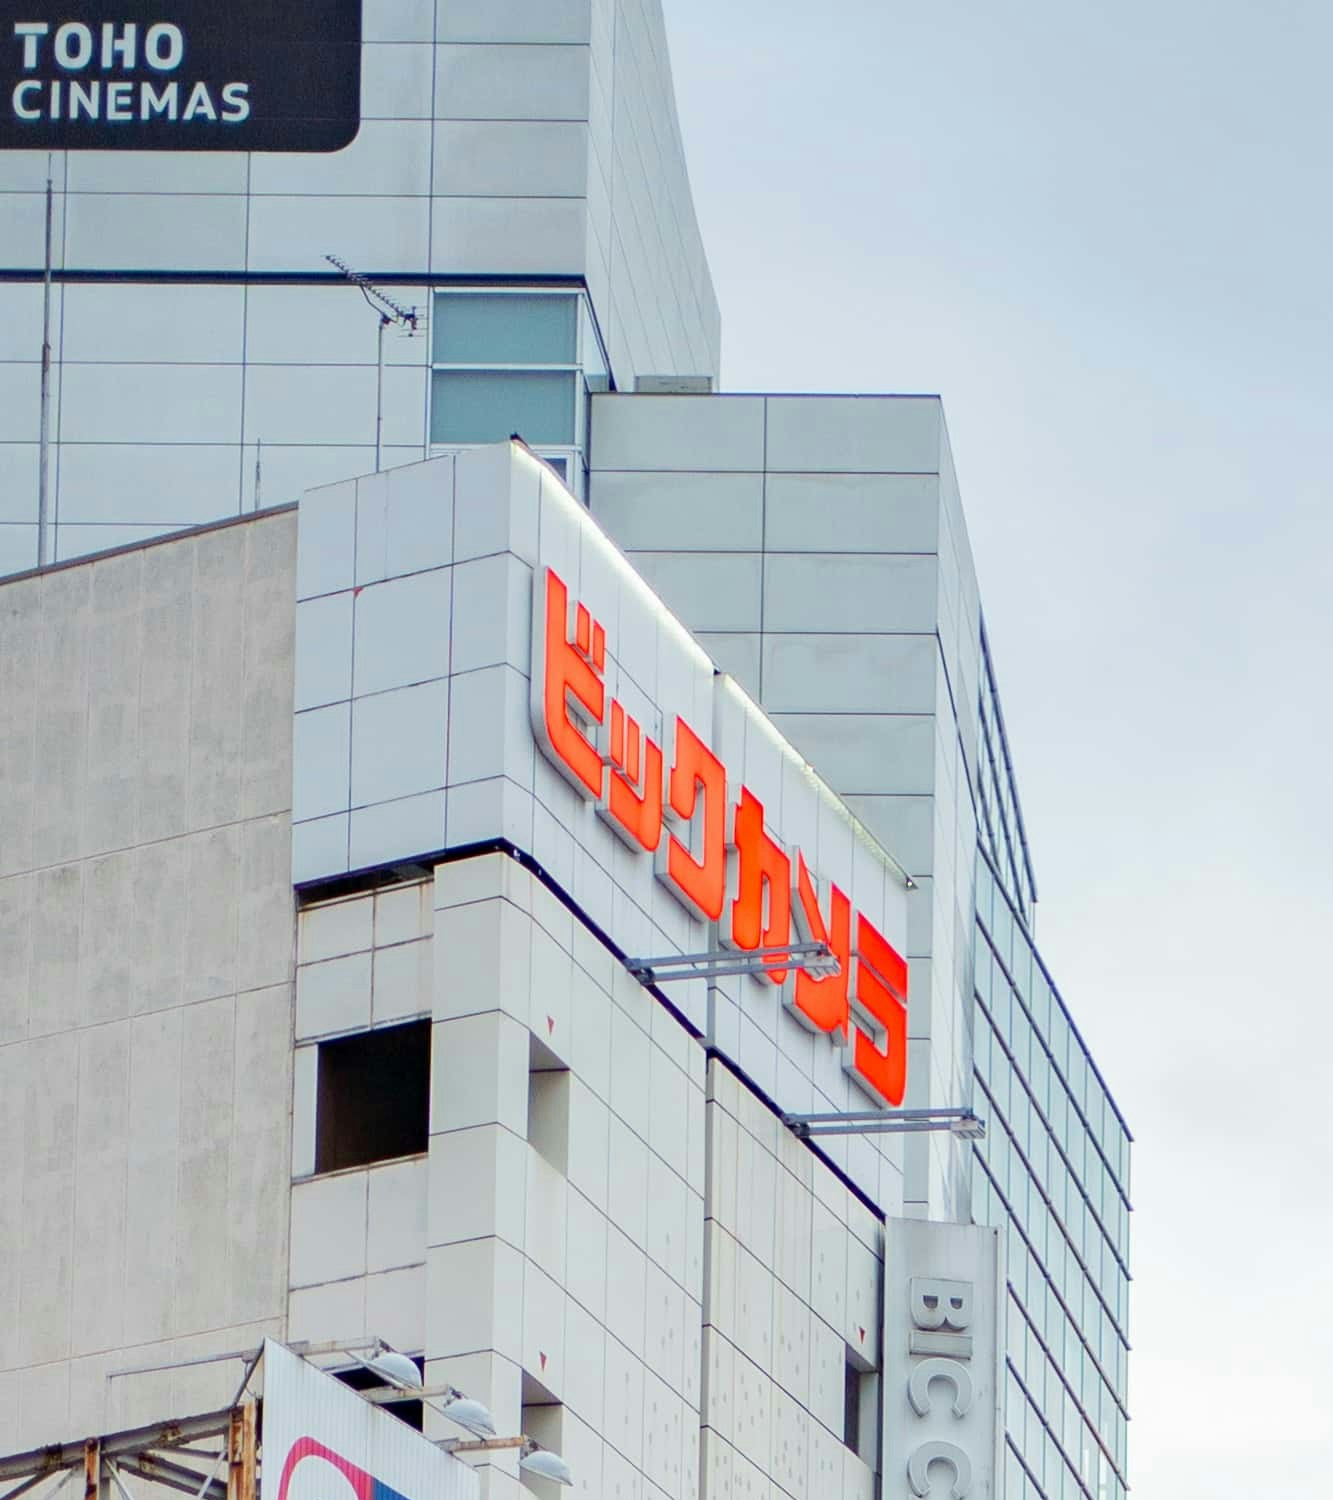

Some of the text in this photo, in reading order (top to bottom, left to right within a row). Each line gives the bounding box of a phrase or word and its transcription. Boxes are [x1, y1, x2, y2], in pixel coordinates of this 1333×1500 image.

[13, 22, 184, 72] TOHO
[12, 81, 252, 124] CINEMAS
[531, 566, 910, 1108] ビックカメラ
[906, 1276, 973, 1421] BIC
